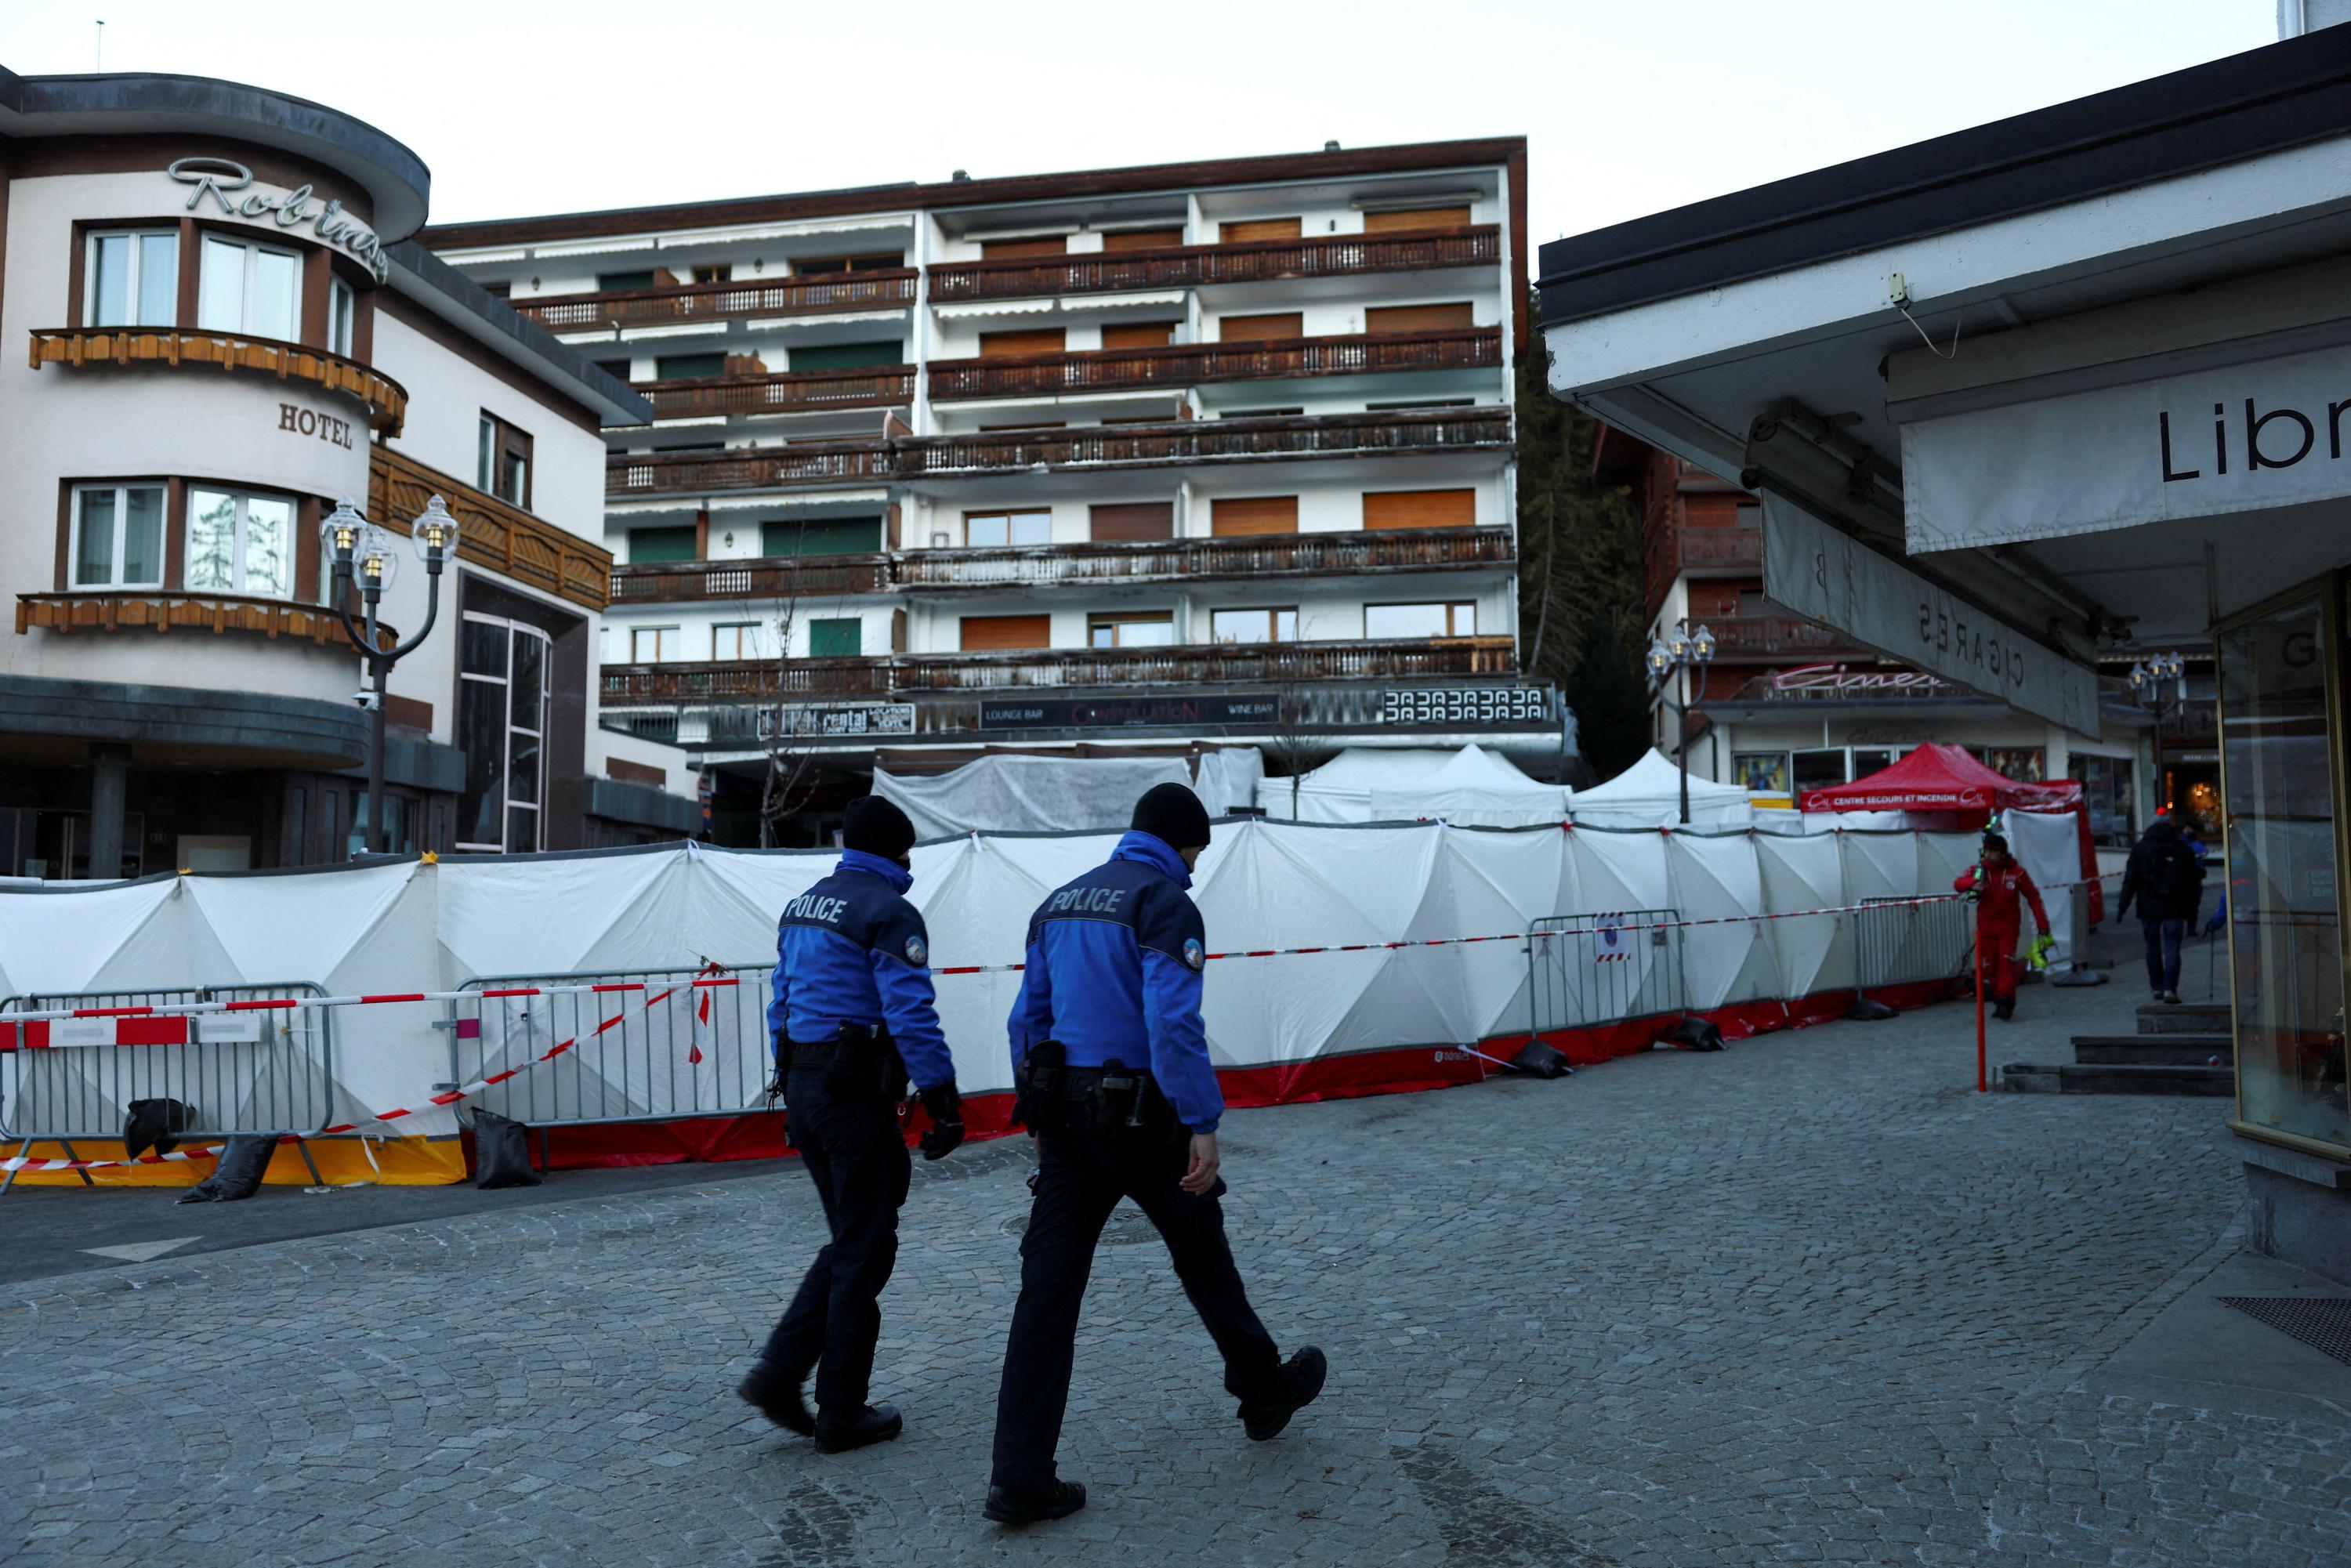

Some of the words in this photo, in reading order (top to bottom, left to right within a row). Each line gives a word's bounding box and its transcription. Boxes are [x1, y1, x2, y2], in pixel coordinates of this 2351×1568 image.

[278, 403, 352, 451] HOTEL
[2160, 398, 2351, 482] Libr
[824, 709, 867, 727] rental
[986, 710, 1022, 720] LOUNGE
[1024, 709, 1043, 719] BAR
[1227, 704, 1252, 715] WINE
[1254, 704, 1273, 714] BAR
[1905, 795, 1914, 803] ET
[786, 895, 847, 923] POLICE
[1049, 888, 1126, 913] POLICE
